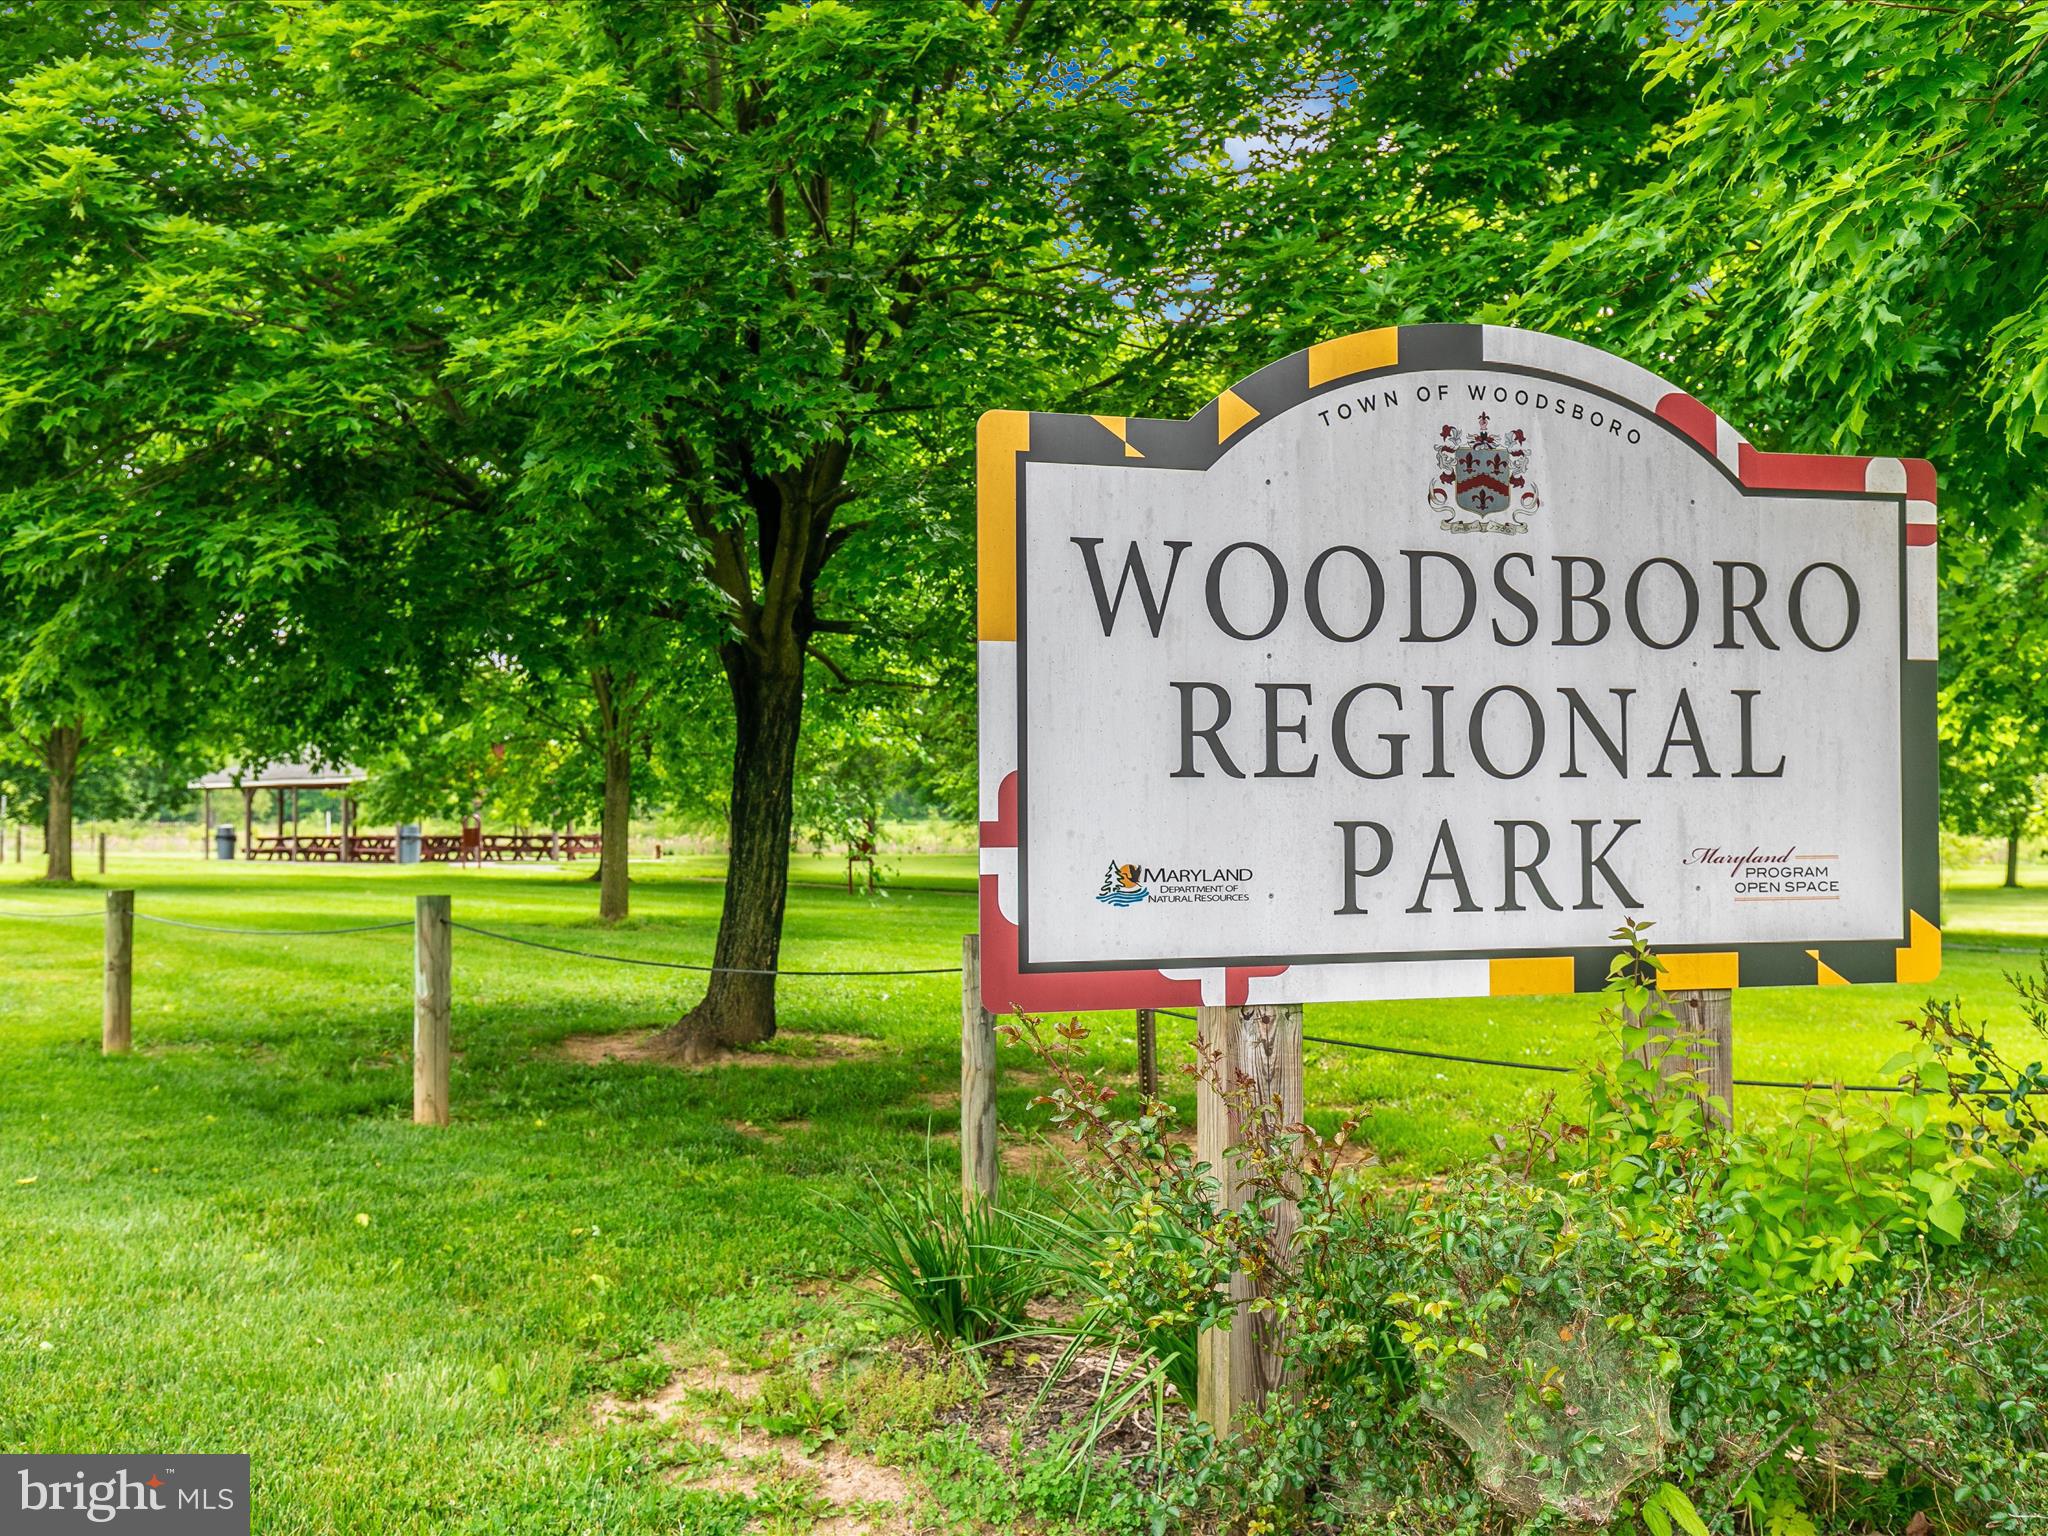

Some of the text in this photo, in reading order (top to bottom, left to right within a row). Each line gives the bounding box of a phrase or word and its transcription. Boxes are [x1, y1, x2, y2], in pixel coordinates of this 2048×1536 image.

[1317, 384, 1641, 446] TOWN OF WOODSBORO
[1069, 536, 1861, 653] WOODSBORO
[1169, 681, 1786, 780] REGIONAL
[1333, 818, 1644, 916] PARK
[1682, 845, 1797, 878] Maryland
[1745, 866, 1829, 879] PROGRAM
[1143, 867, 1254, 883] MARYLAND
[1734, 880, 1840, 894] OPEN SPACE
[1148, 893, 1250, 903] NATURAL RESOURCES
[1160, 884, 1239, 894] DEPARTMENT OF
